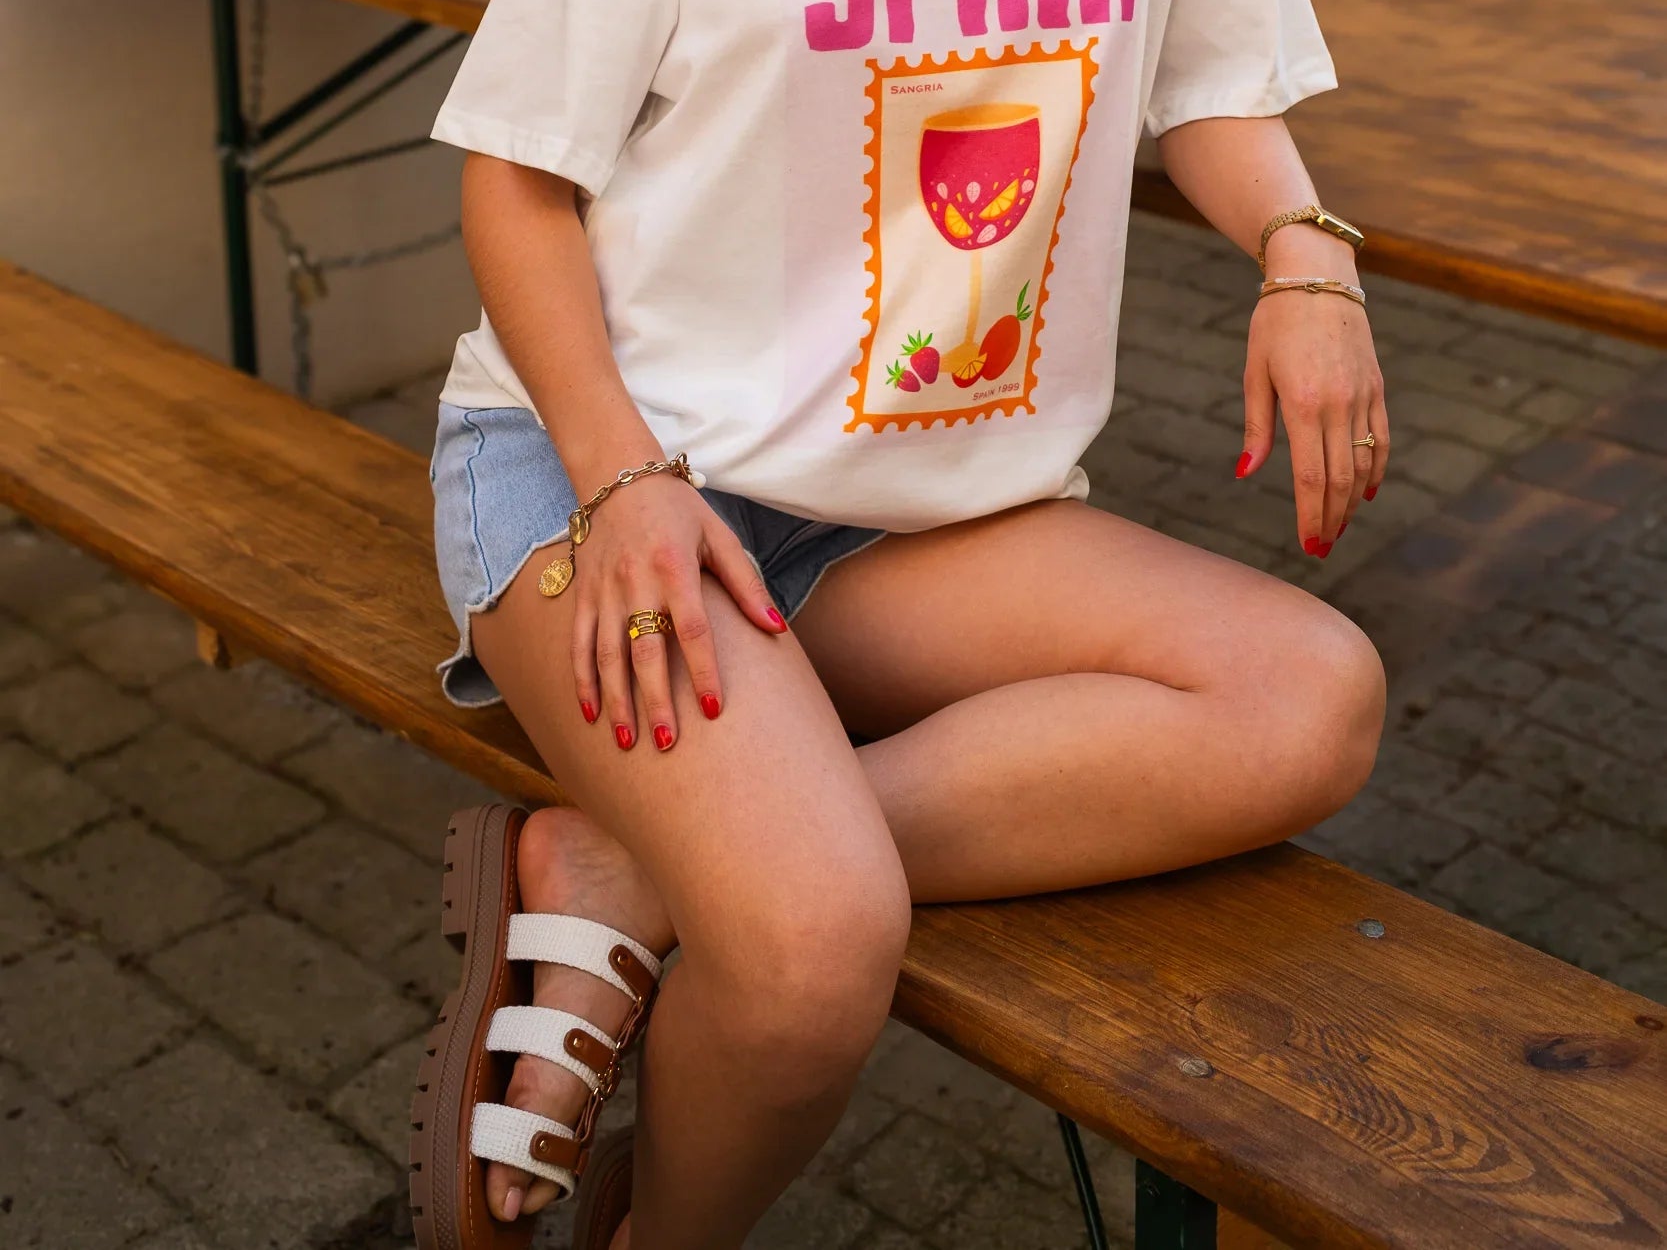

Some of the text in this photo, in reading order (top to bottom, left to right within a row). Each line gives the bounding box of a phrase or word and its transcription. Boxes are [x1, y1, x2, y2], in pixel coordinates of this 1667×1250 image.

[890, 83, 943, 95] SANGRIA
[972, 382, 1020, 401] SPAIN 1999
